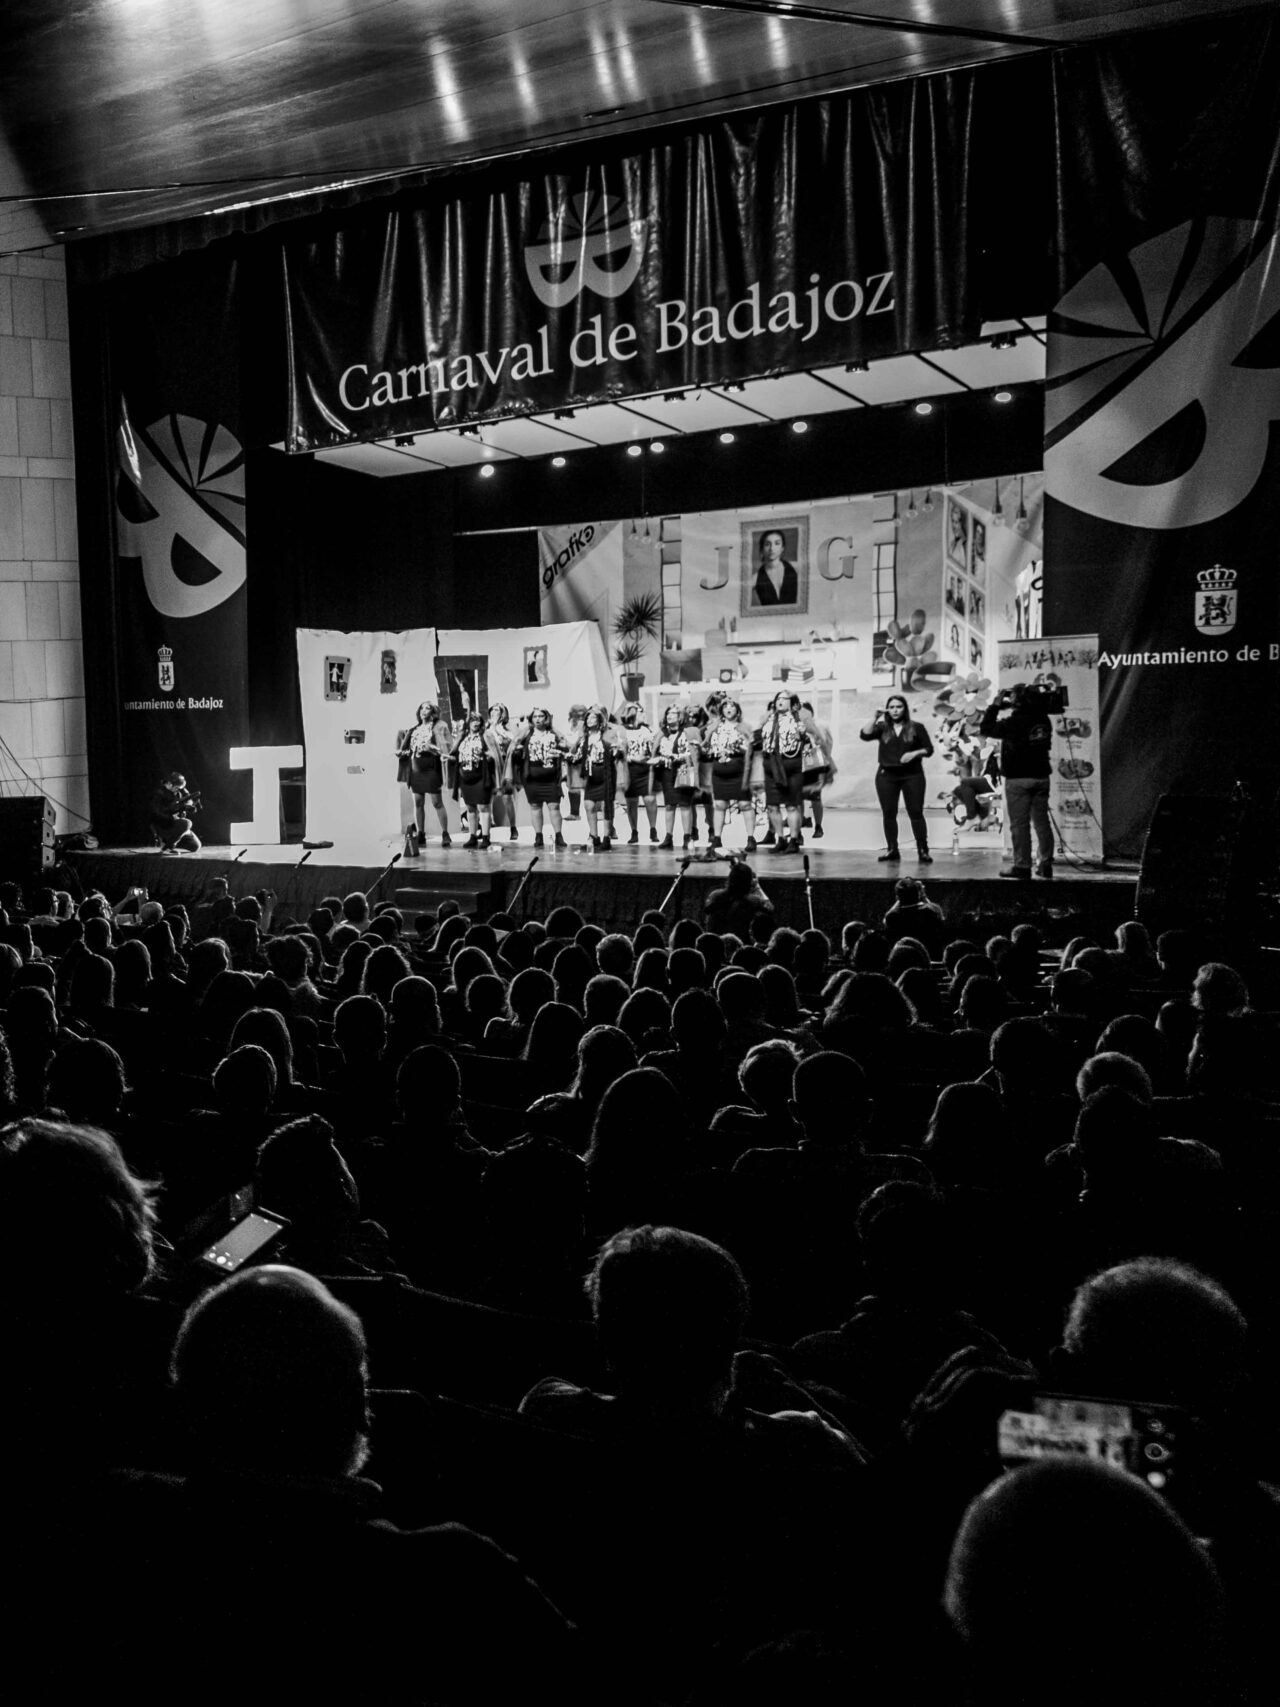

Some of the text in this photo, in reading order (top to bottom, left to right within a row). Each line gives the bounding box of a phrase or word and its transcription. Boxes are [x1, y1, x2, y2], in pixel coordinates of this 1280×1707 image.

[338, 271, 895, 412] Carnaval de Badajoz
[1097, 647, 1229, 670] Ayuntamiento
[1236, 644, 1261, 662] de
[175, 698, 186, 709] de
[188, 696, 223, 710] Badajoz
